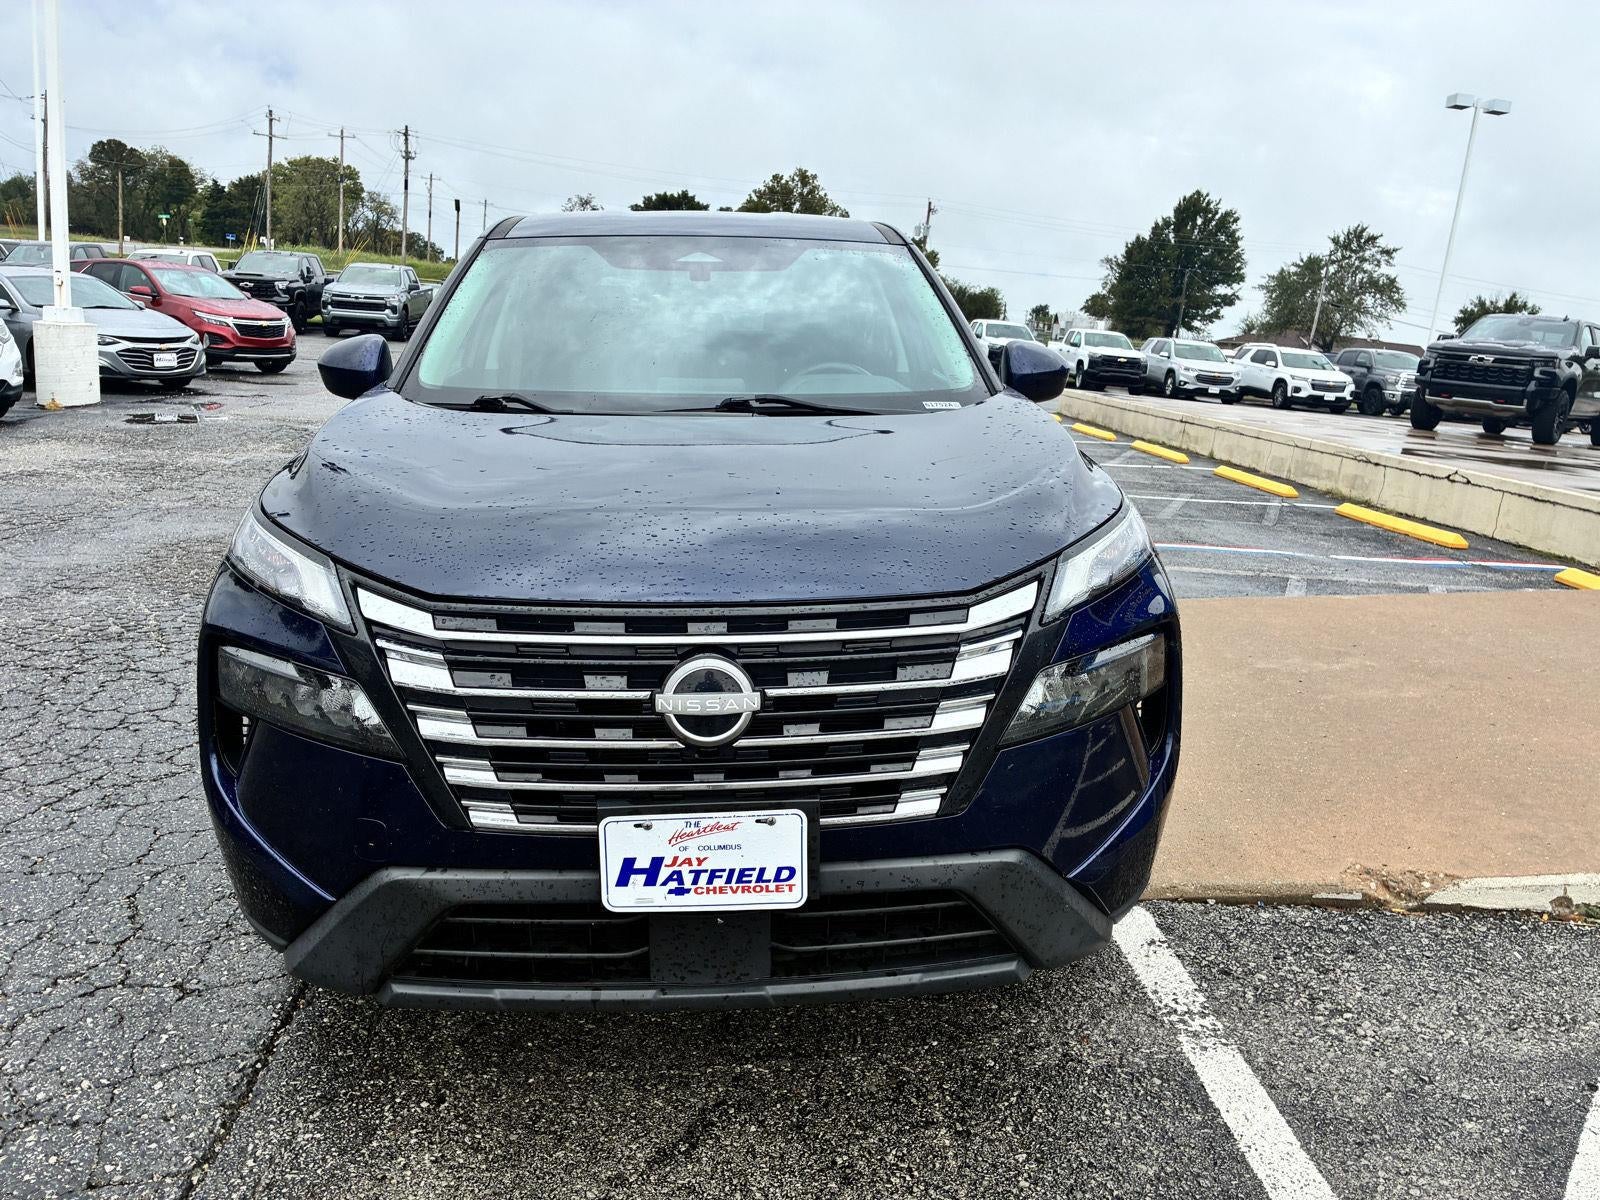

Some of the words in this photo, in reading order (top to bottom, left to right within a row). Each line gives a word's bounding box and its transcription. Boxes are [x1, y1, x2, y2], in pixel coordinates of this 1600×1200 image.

[658, 697, 758, 711] NISSAN
[668, 821, 743, 845] Heartbeat
[697, 843, 742, 851] COLUMBUS
[664, 856, 709, 867] JAY
[615, 856, 797, 887] HATFIELD
[693, 884, 796, 895] CHEVROLET
